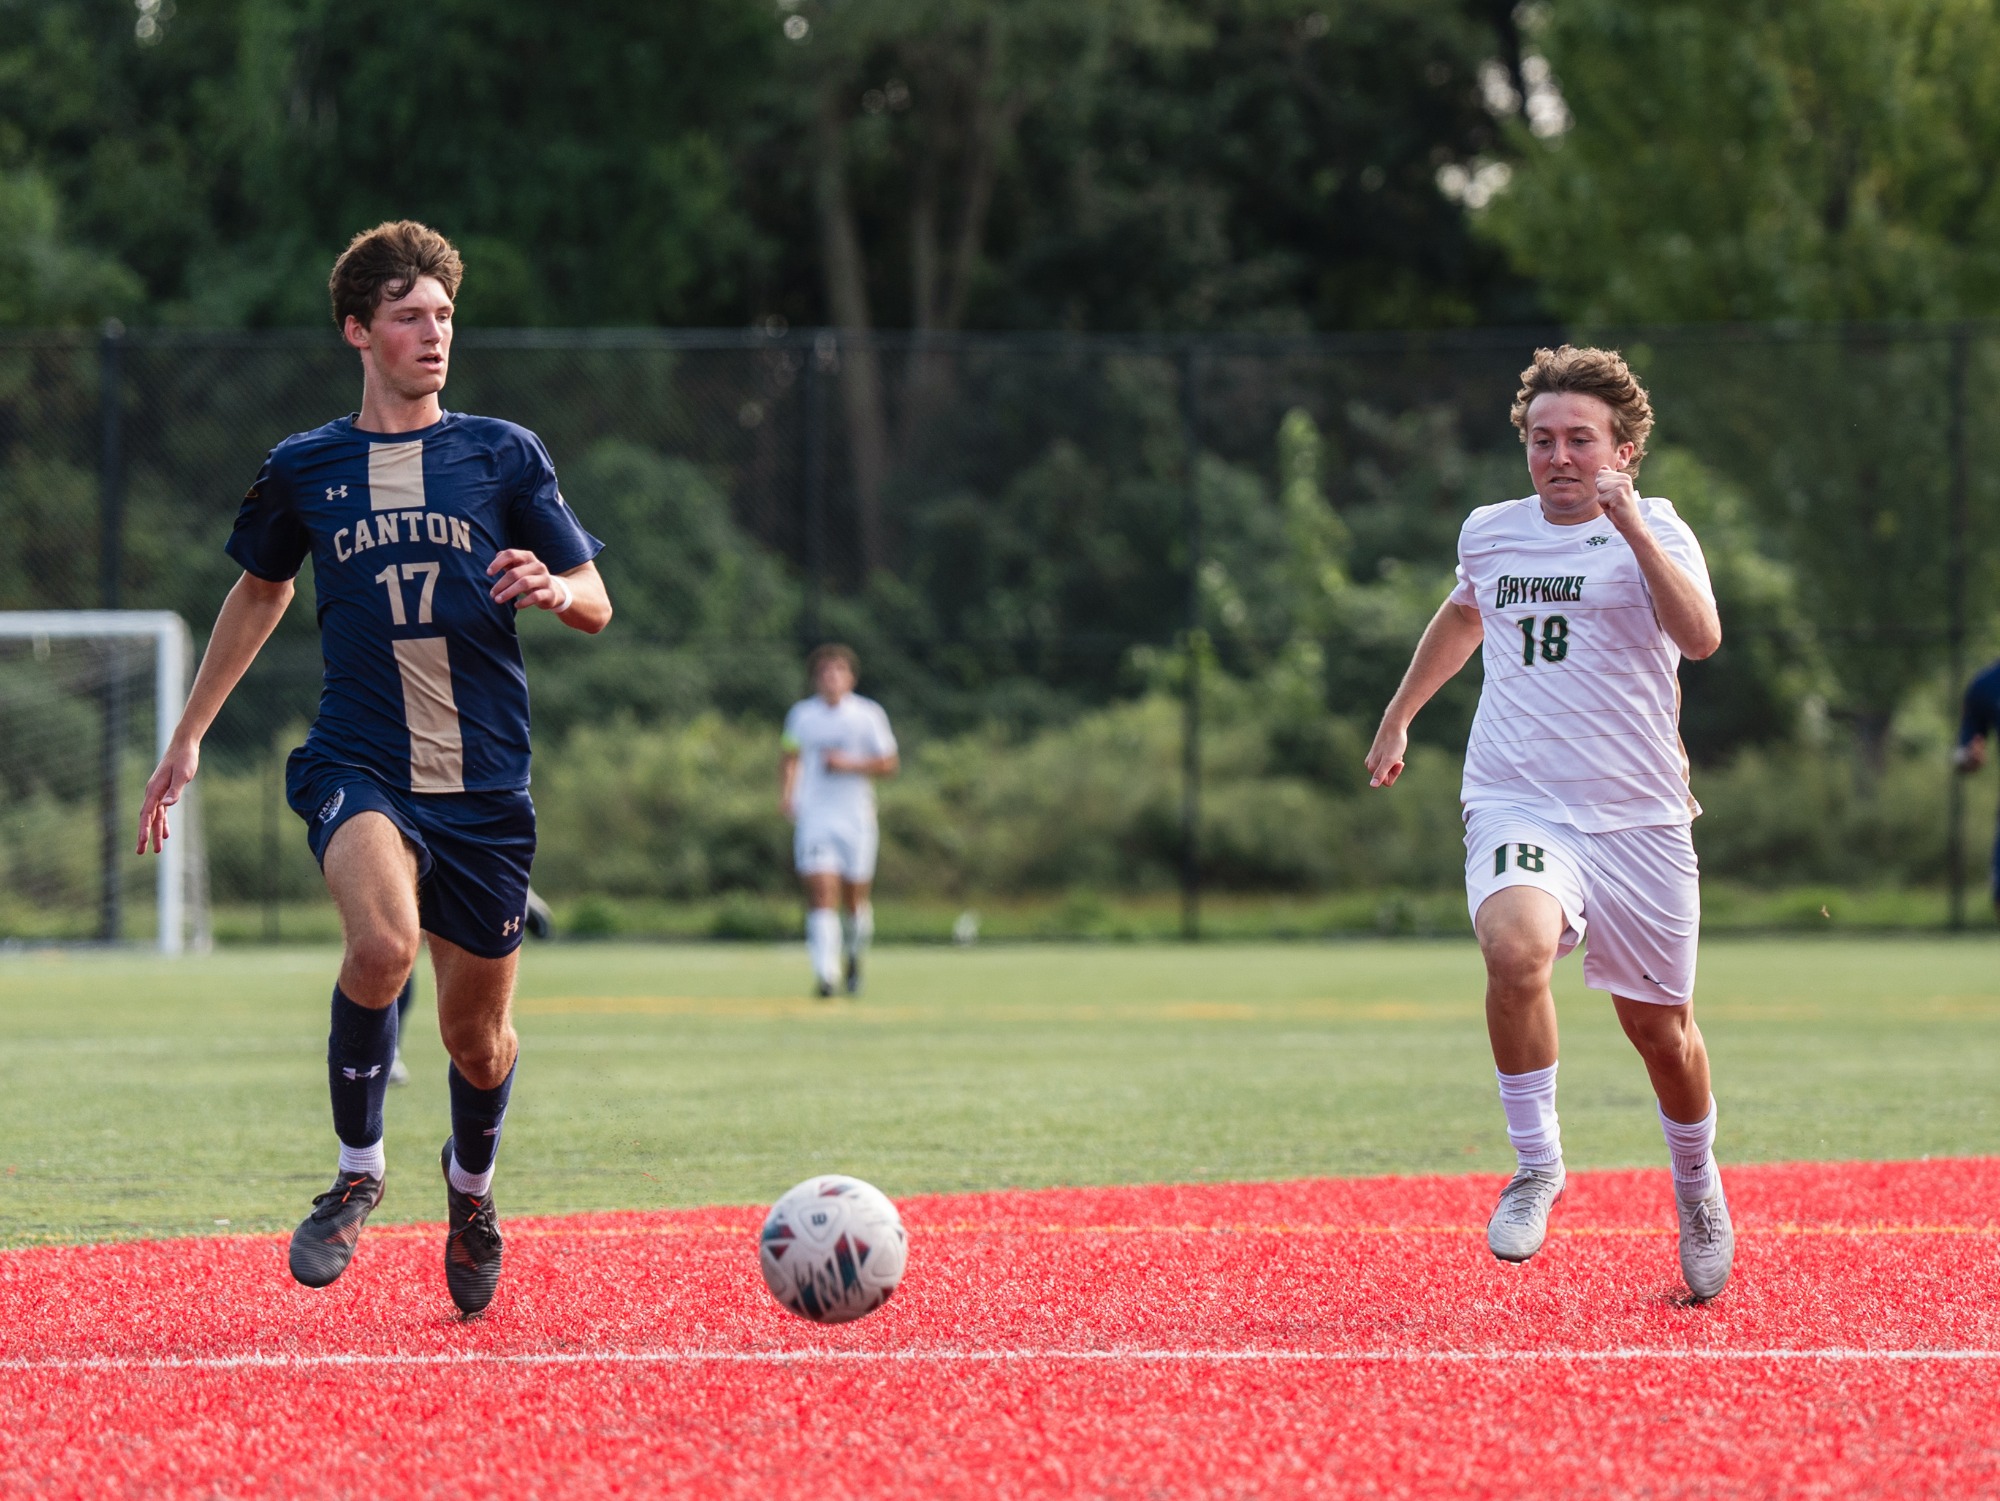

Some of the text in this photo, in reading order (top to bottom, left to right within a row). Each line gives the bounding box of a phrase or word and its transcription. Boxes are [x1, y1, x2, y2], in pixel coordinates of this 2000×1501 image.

[334, 512, 472, 562] CANTON
[375, 561, 441, 625] 17
[1495, 574, 1587, 609] GRYPHONS
[1516, 615, 1569, 667] 18
[1493, 843, 1546, 878] 18
